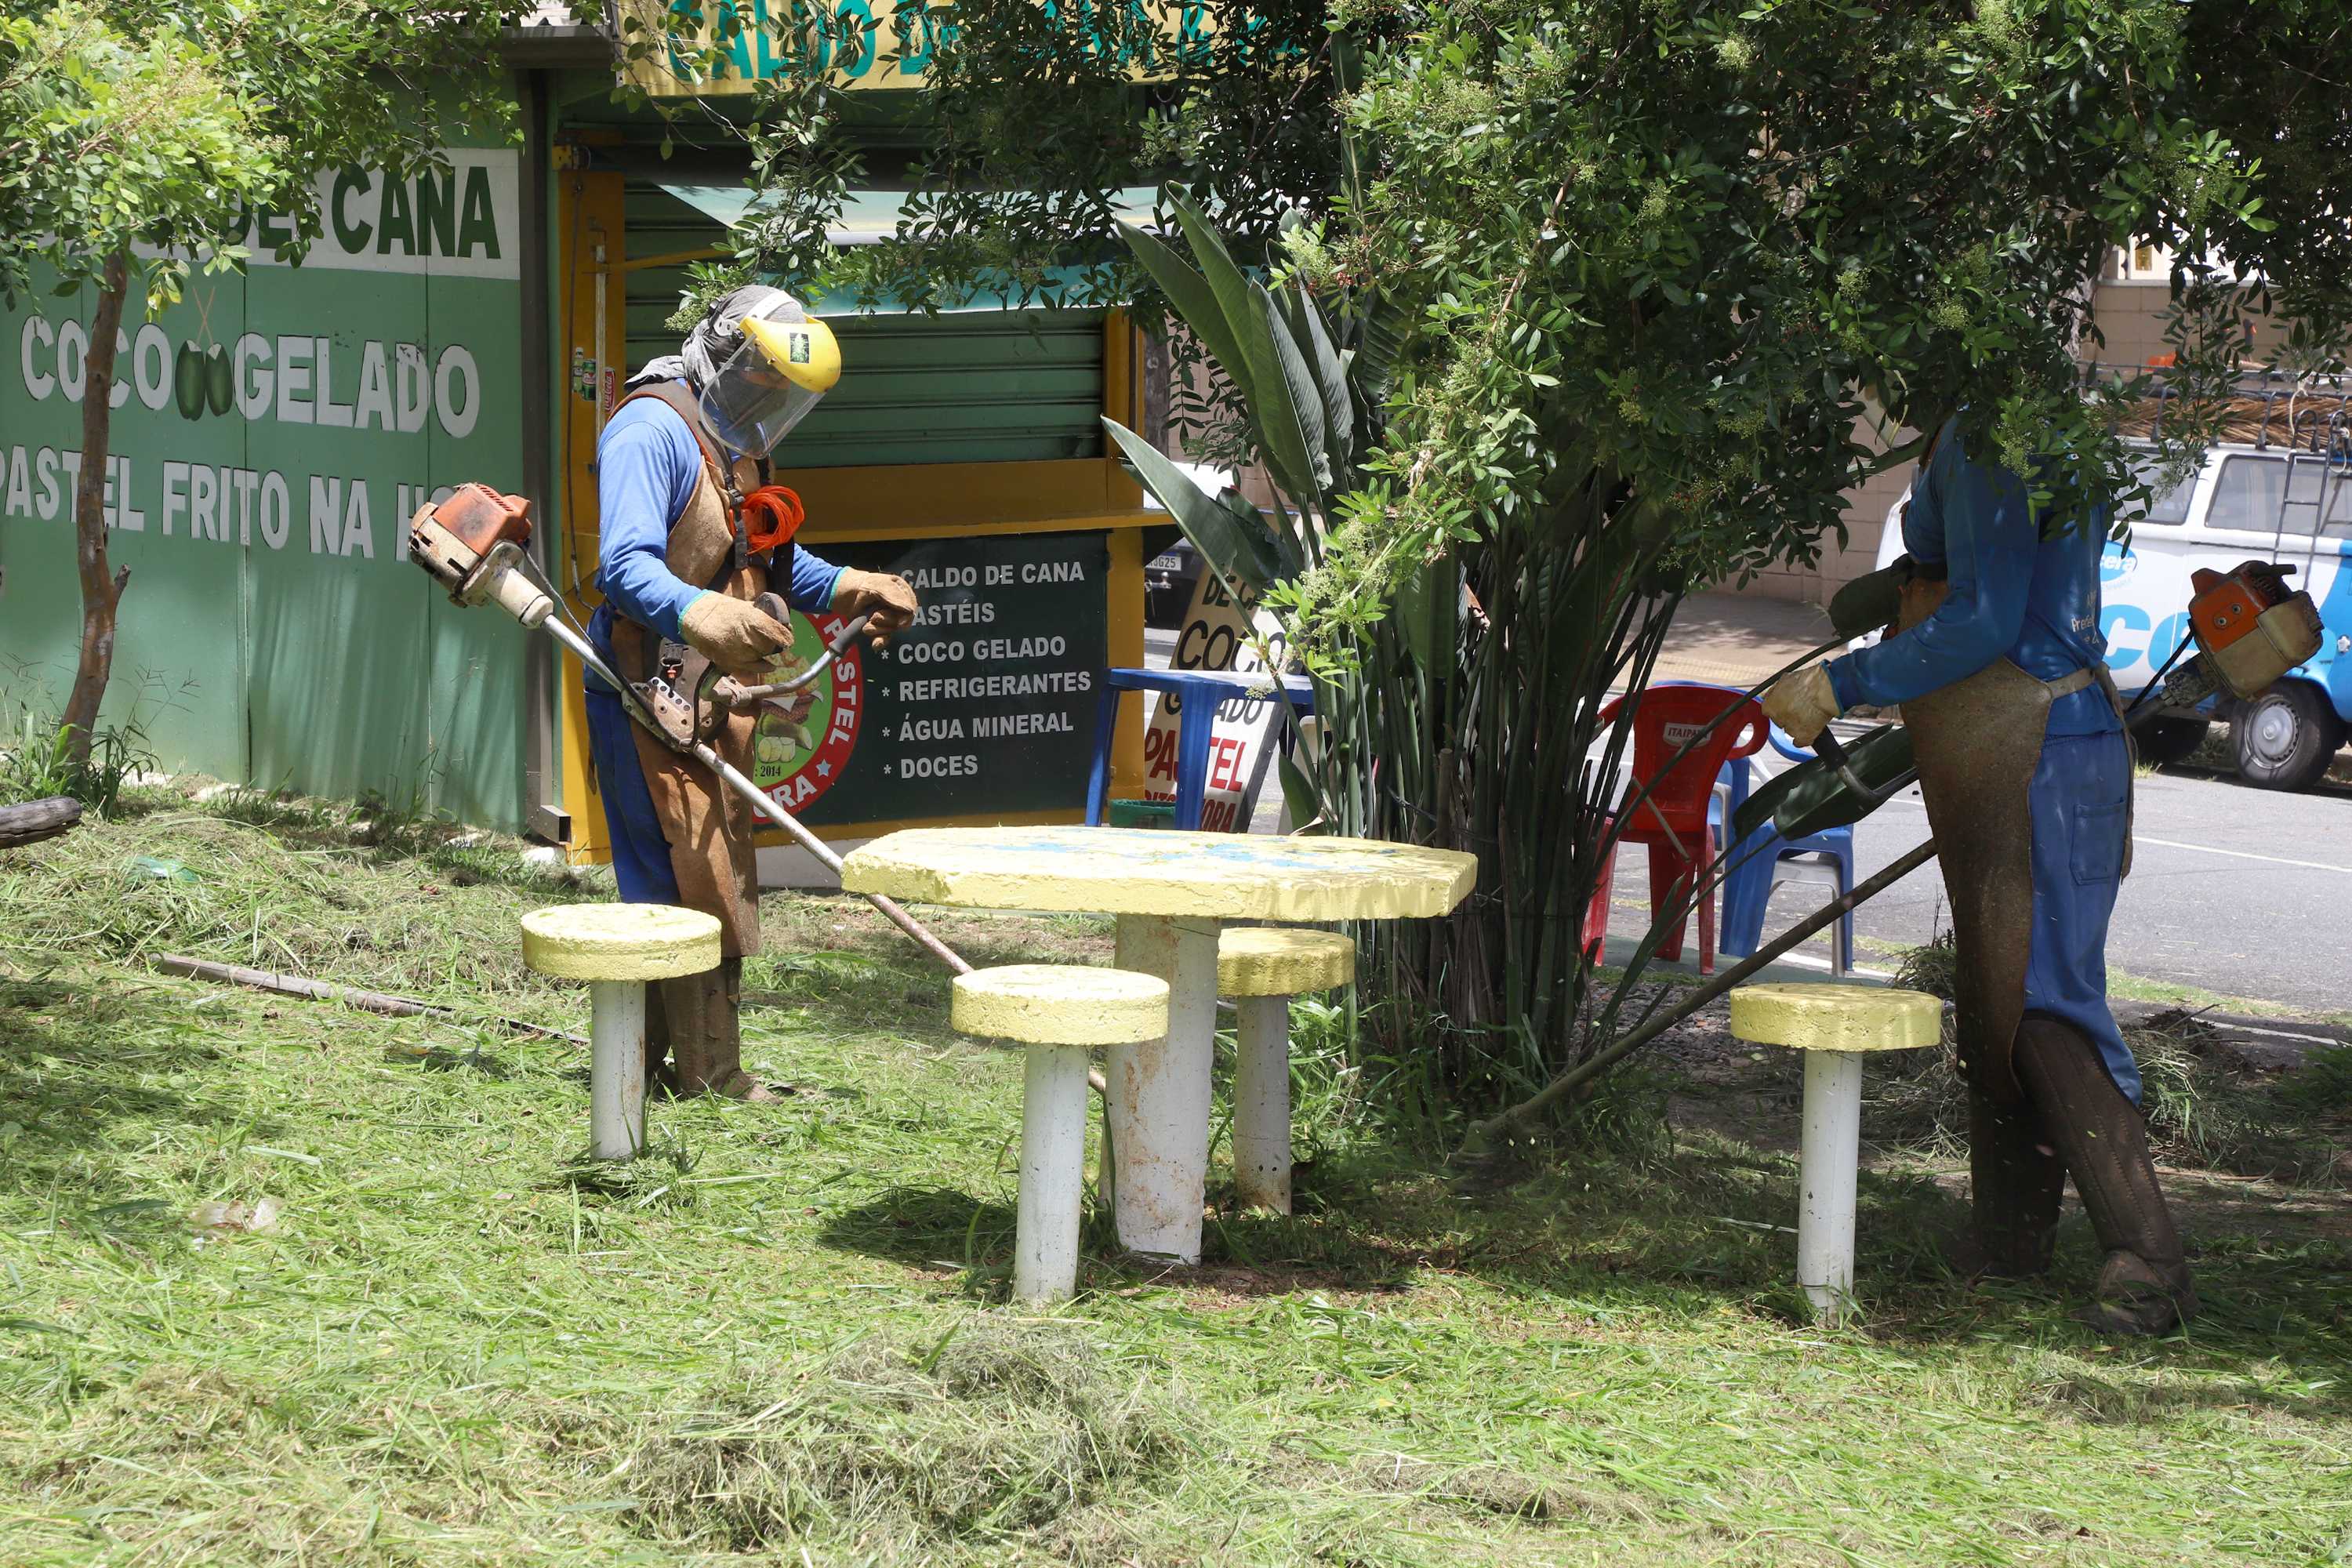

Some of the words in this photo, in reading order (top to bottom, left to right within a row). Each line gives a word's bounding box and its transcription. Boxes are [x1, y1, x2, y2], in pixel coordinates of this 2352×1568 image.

[332, 161, 501, 259] CANA
[234, 332, 480, 438] GELADO
[0, 445, 144, 532] ASTEL
[162, 460, 290, 550] FRITO
[309, 474, 374, 559] NA
[902, 566, 977, 589] CALDO
[985, 564, 1014, 586] DE
[1022, 561, 1085, 583] CANA
[2100, 554, 2136, 573] cera
[2101, 577, 2132, 593] ENHARIA
[910, 598, 995, 626] ASTÉIS
[898, 641, 964, 664] COCO
[973, 635, 1065, 660] GELADO
[1177, 619, 1287, 673] COCO
[823, 618, 858, 745] PSTEL
[899, 671, 1091, 701] REFRIGERANTES
[1164, 692, 1265, 726] GADO
[899, 713, 964, 741] ÁGUA
[972, 712, 1074, 737] MINERAL
[1668, 727, 1708, 739] ITAIPA
[760, 765, 782, 777] 2014
[901, 754, 978, 779] DOCES
[1145, 728, 1247, 793] PAEL
[1201, 797, 1237, 833] ORA
